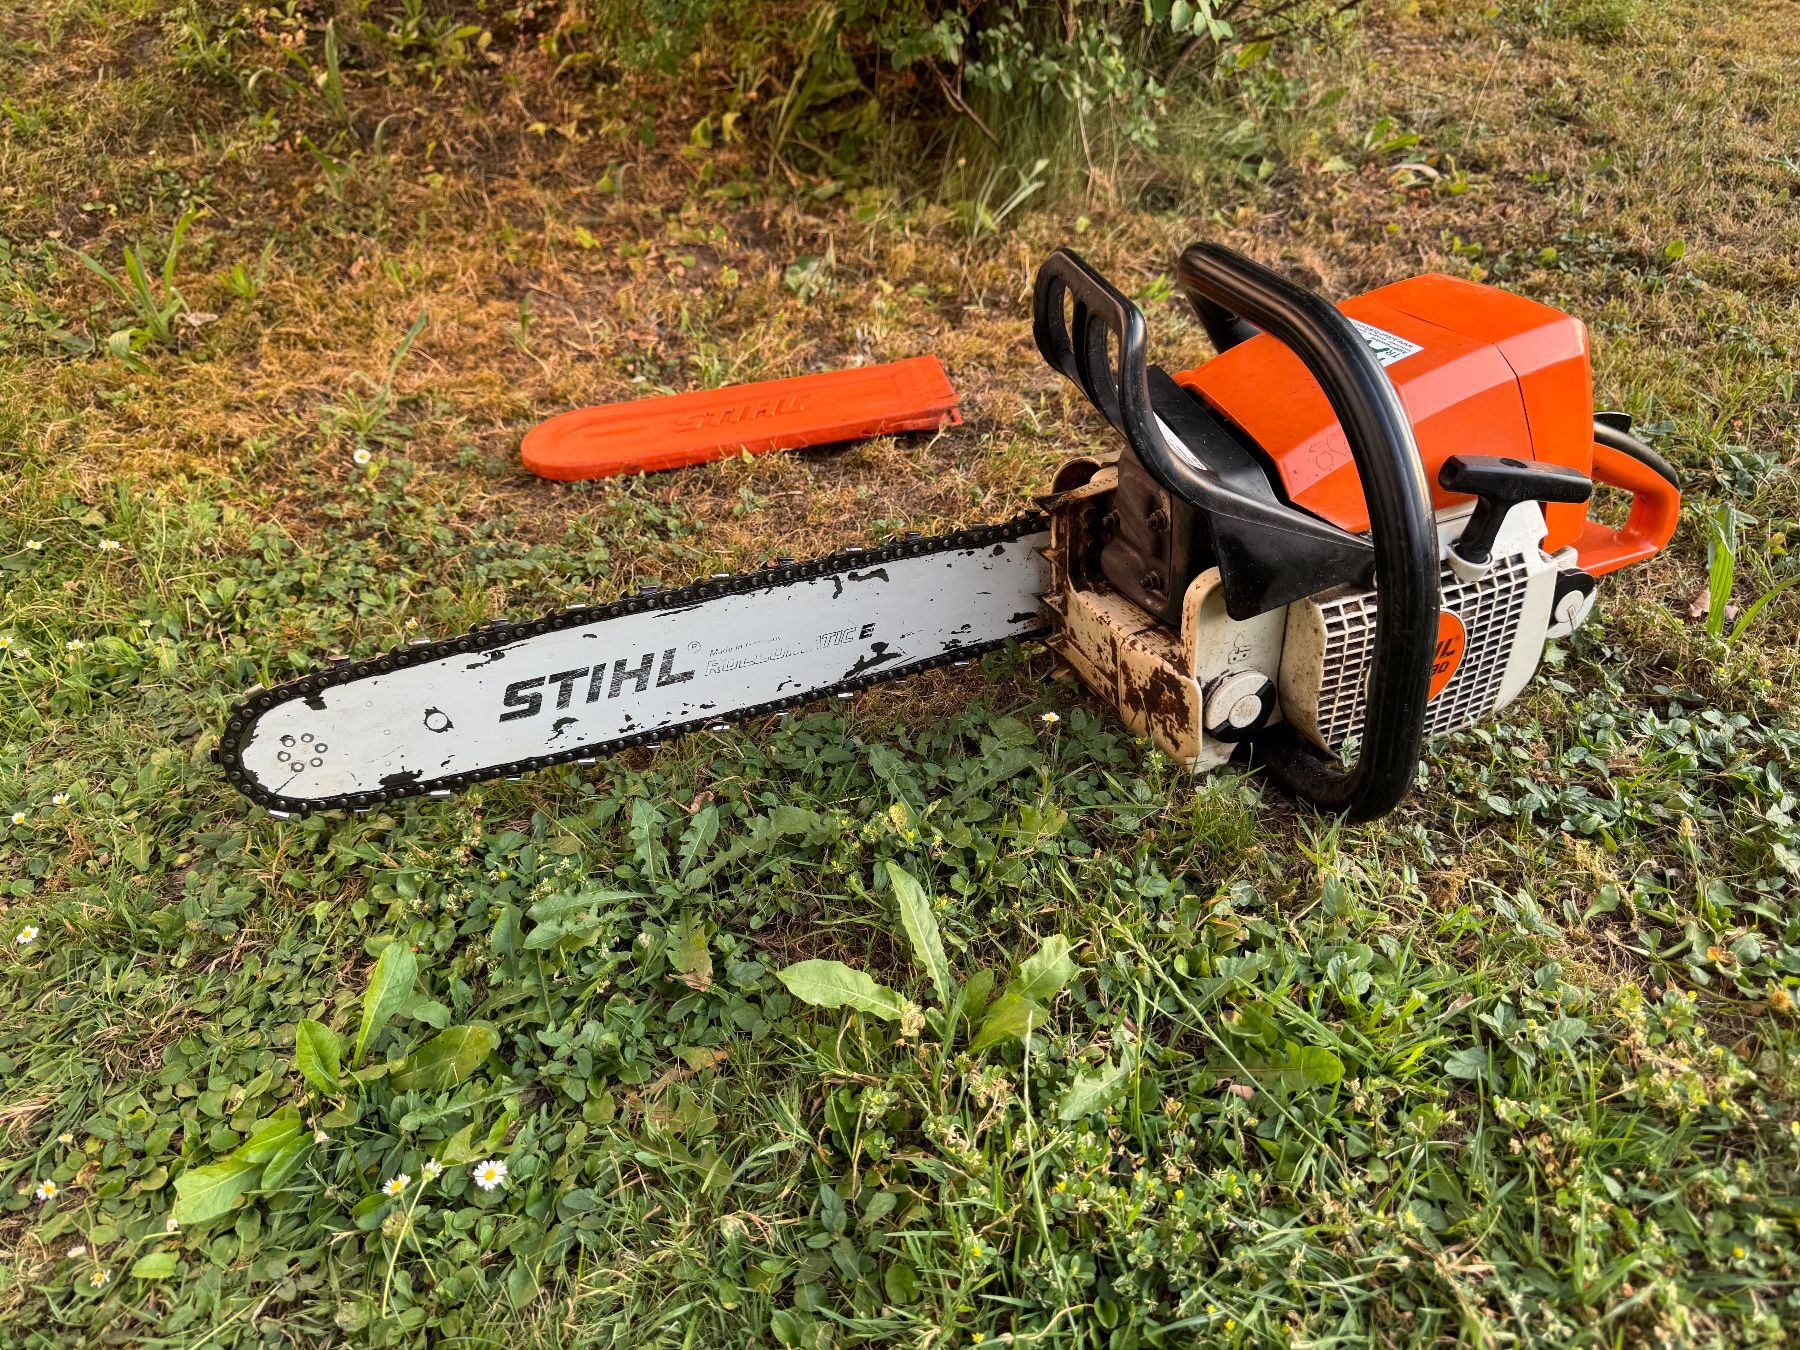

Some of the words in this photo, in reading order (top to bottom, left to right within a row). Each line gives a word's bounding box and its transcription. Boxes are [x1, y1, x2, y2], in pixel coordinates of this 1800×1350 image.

[672, 395, 804, 433] STIHL
[704, 626, 857, 677] ROLLOTIC
[709, 646, 733, 657] Made
[499, 647, 696, 723] STIHL
